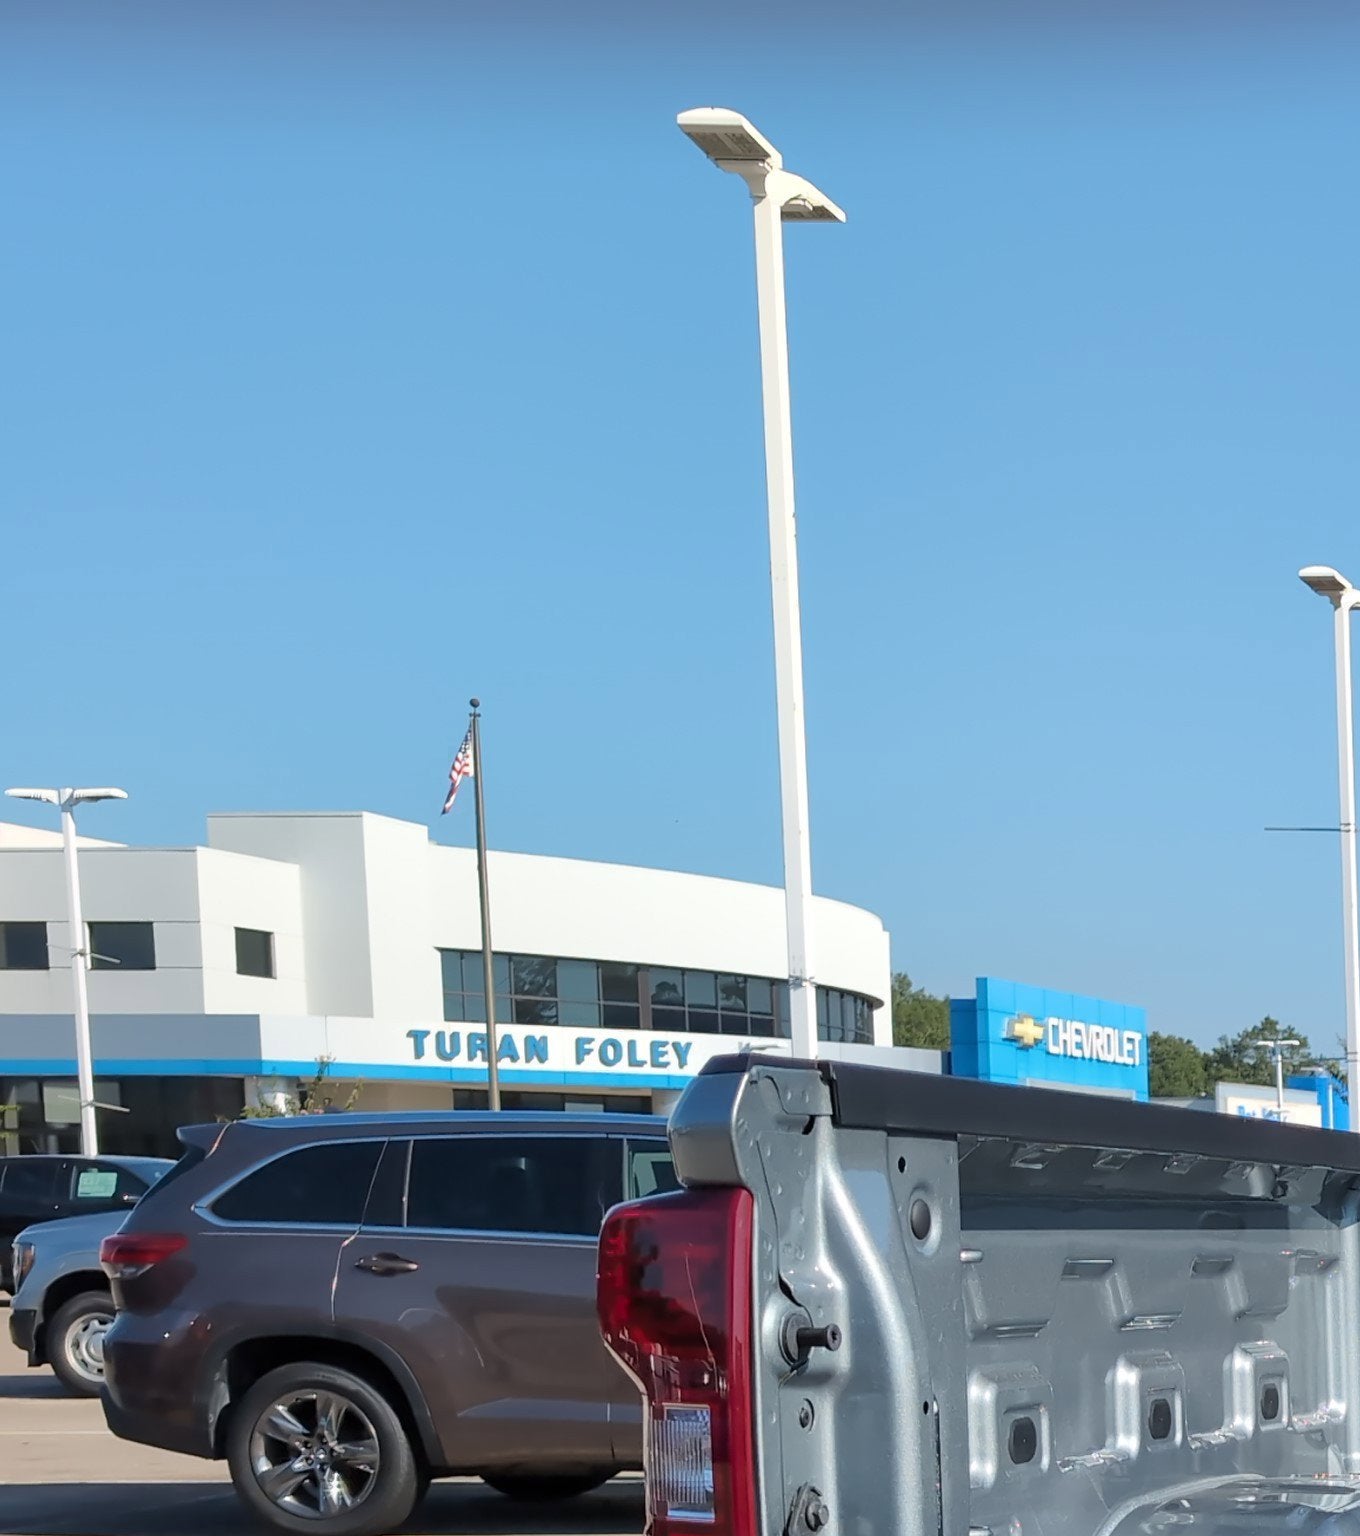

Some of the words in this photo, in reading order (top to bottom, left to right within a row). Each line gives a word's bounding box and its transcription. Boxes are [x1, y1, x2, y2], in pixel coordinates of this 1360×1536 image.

[406, 1029, 549, 1065] TURAN
[575, 1036, 693, 1070] FOLEY
[1047, 1016, 1142, 1066] CHEVROLET
